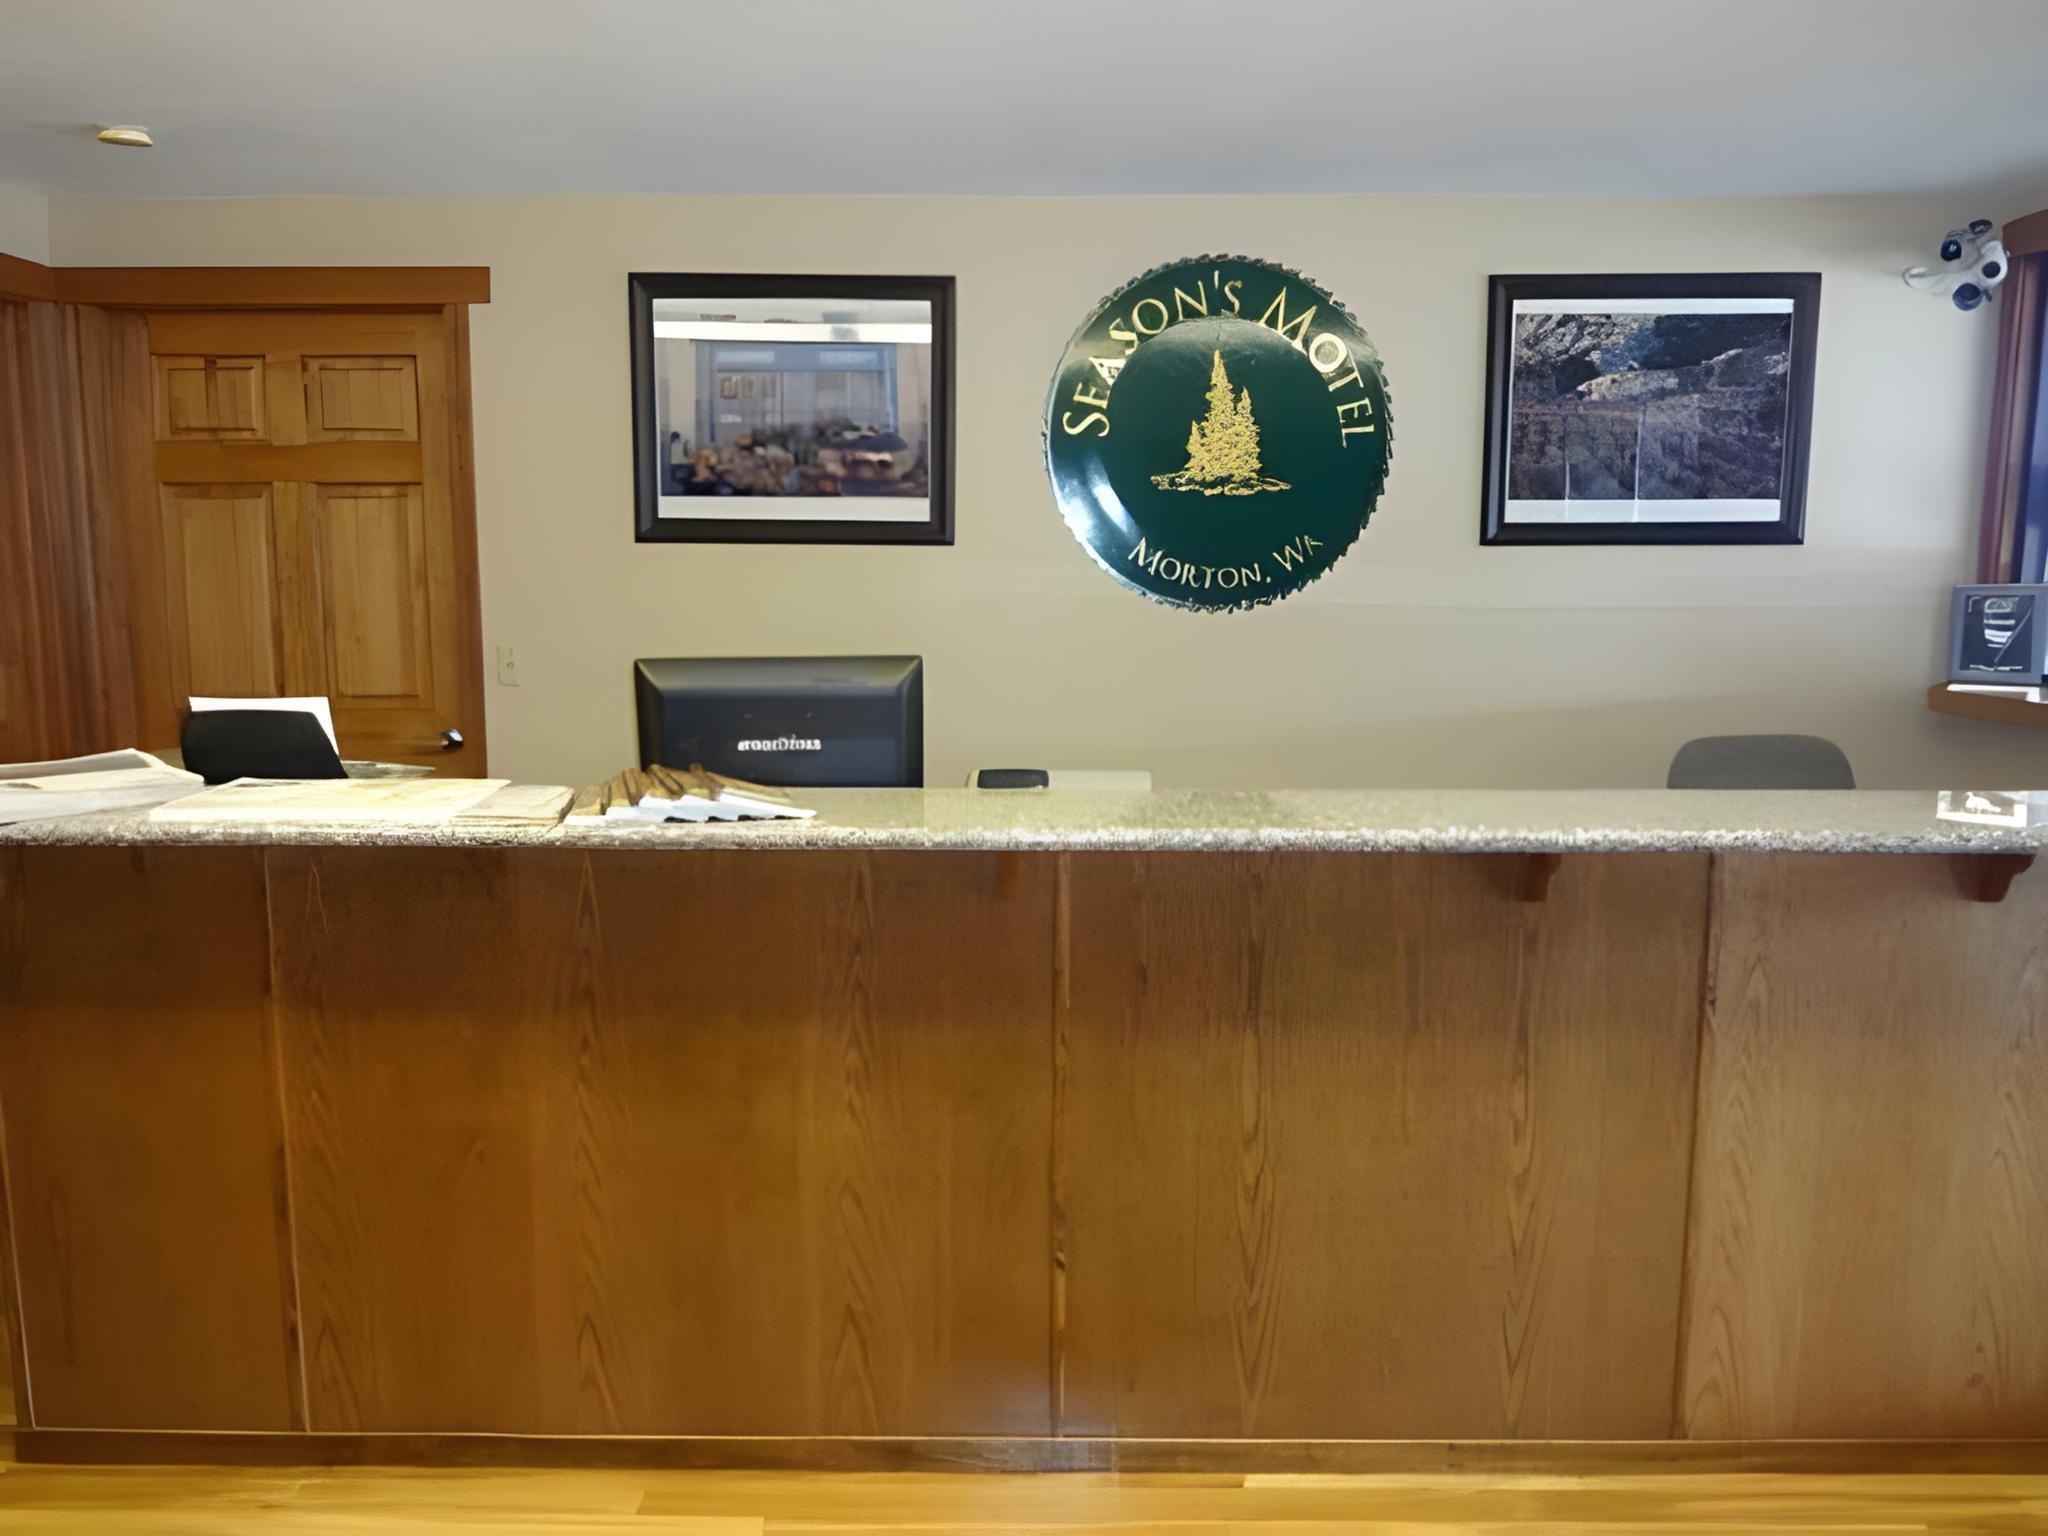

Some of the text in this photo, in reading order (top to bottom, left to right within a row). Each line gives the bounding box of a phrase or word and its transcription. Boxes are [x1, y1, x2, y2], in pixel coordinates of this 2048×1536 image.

[1063, 270, 1375, 449] SEASON'S MOTEL
[1272, 534, 1324, 571] WA
